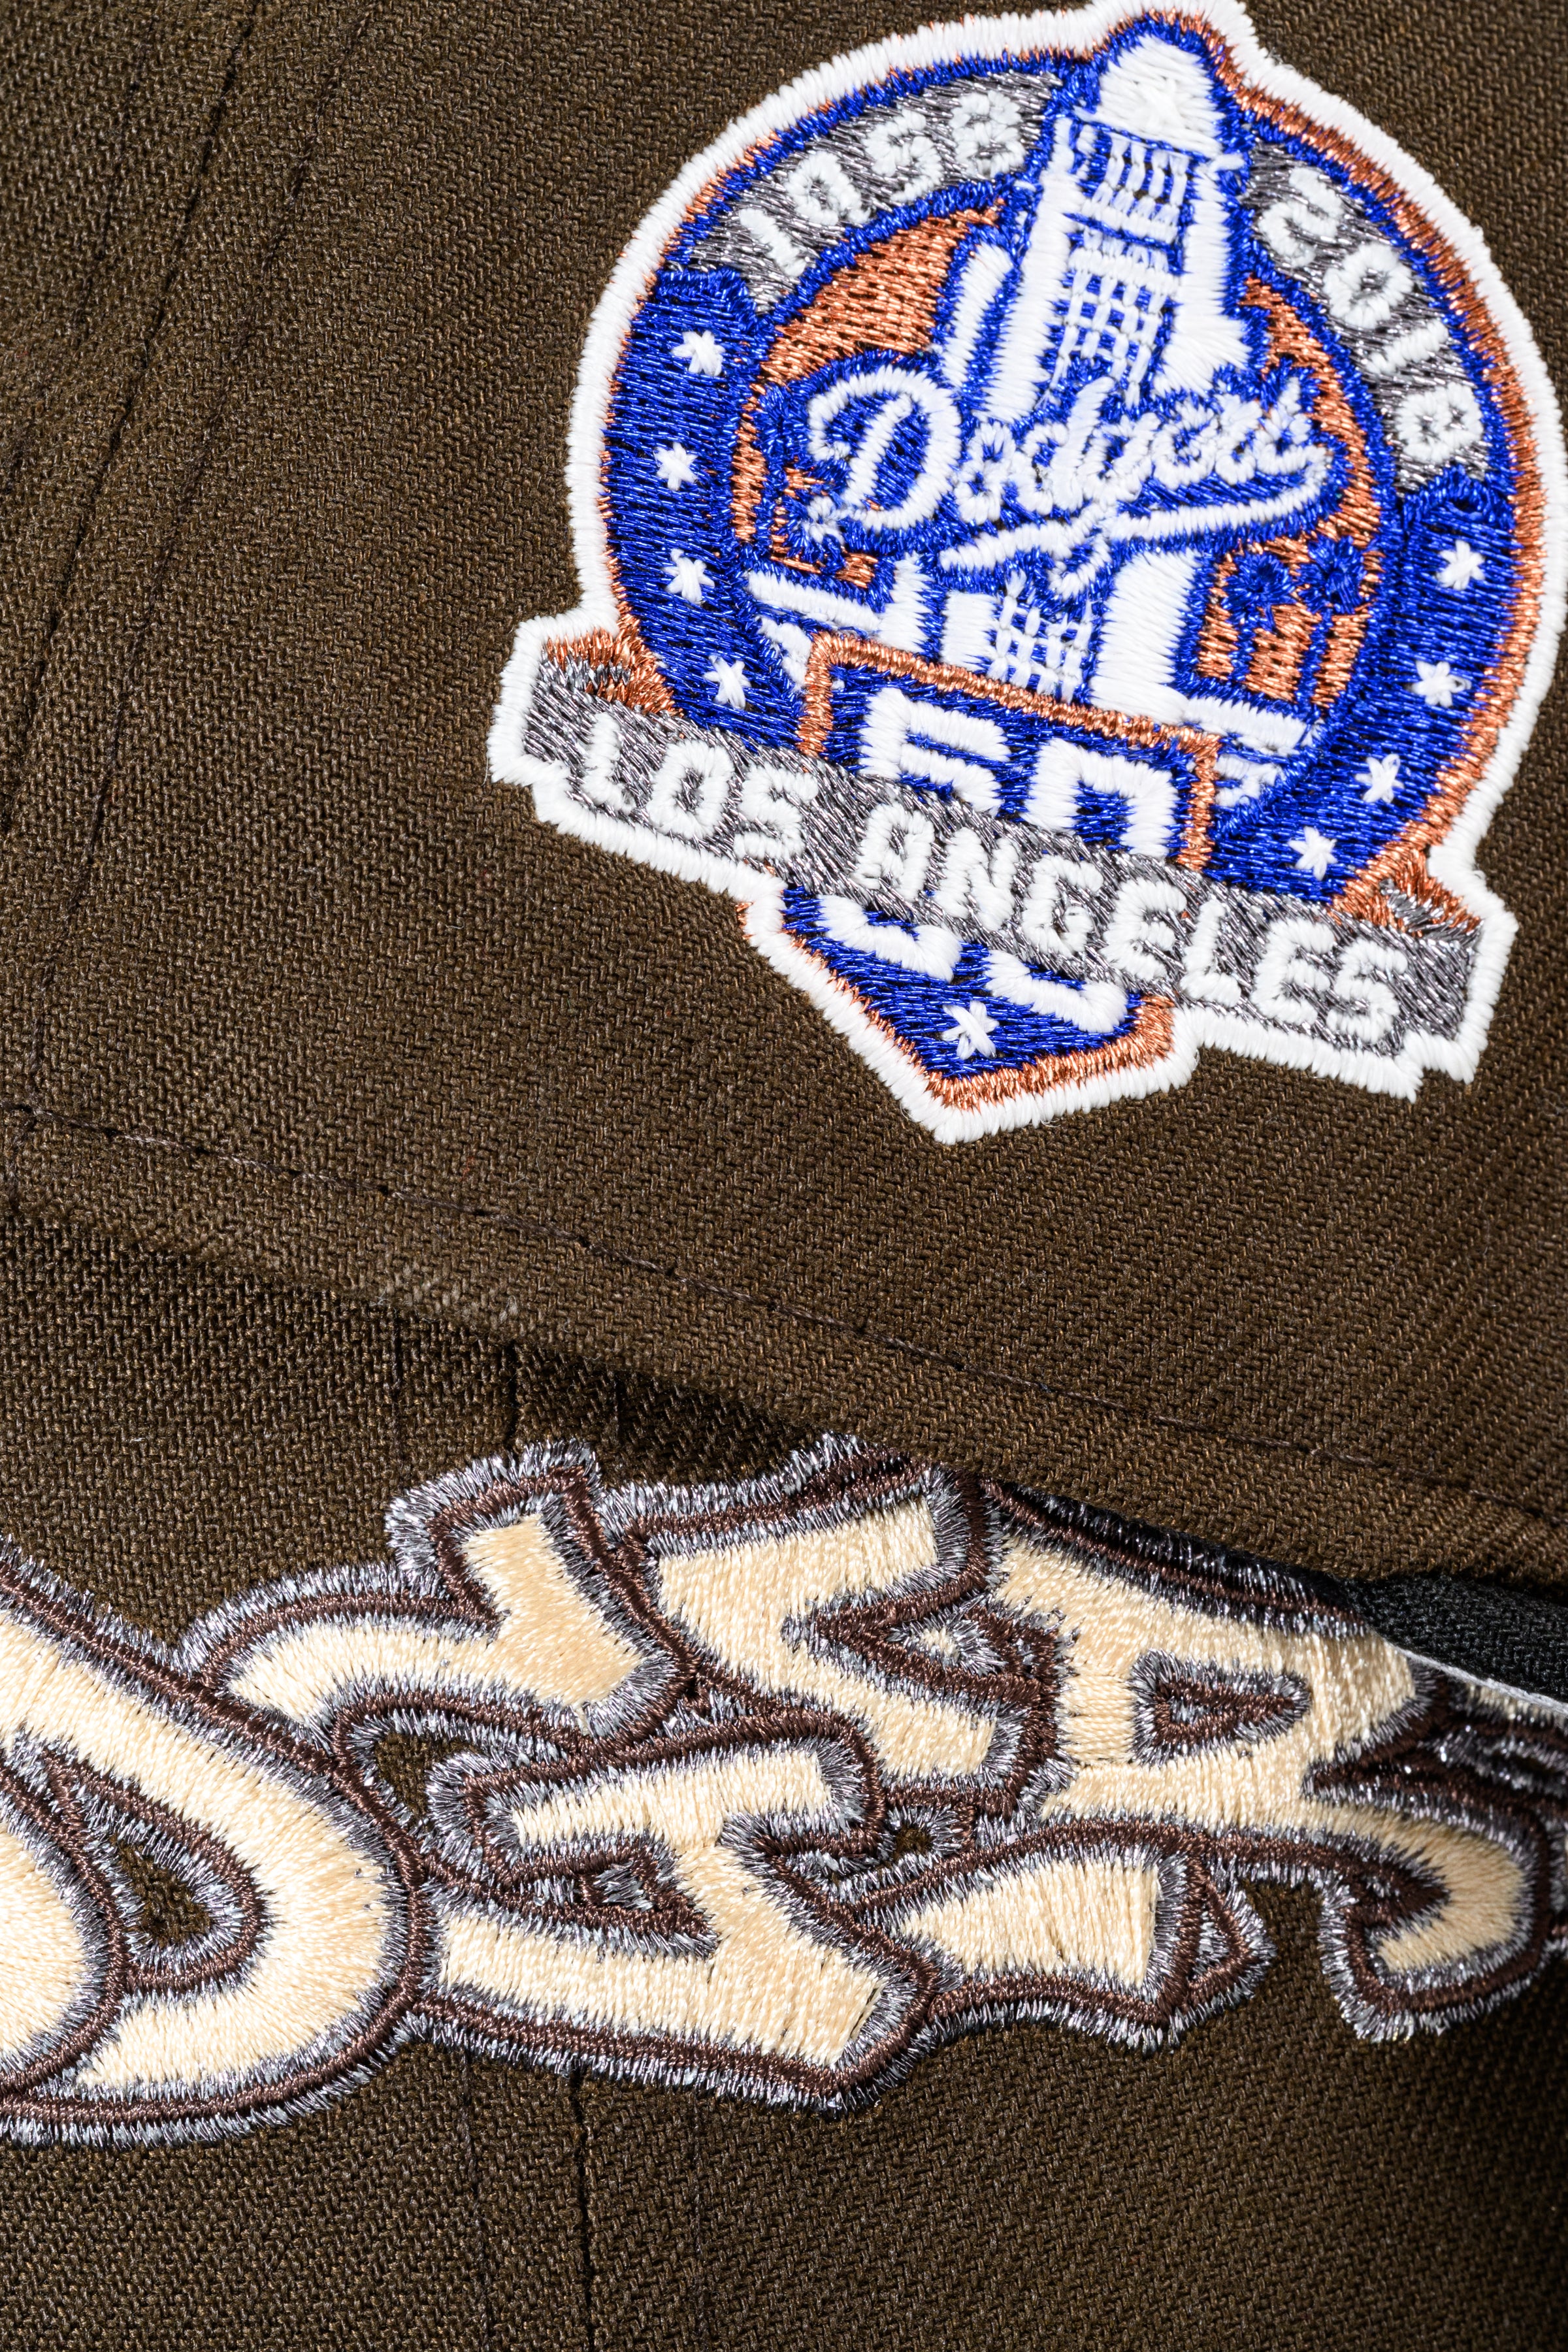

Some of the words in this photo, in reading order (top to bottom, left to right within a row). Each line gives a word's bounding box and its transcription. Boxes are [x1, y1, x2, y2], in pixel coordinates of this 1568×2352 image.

[738, 90, 1026, 277] 1958
[1258, 166, 1486, 464] 2018
[804, 365, 1333, 600] Dodgers
[587, 711, 820, 861] LOS
[849, 801, 1409, 1044] ANGELES
